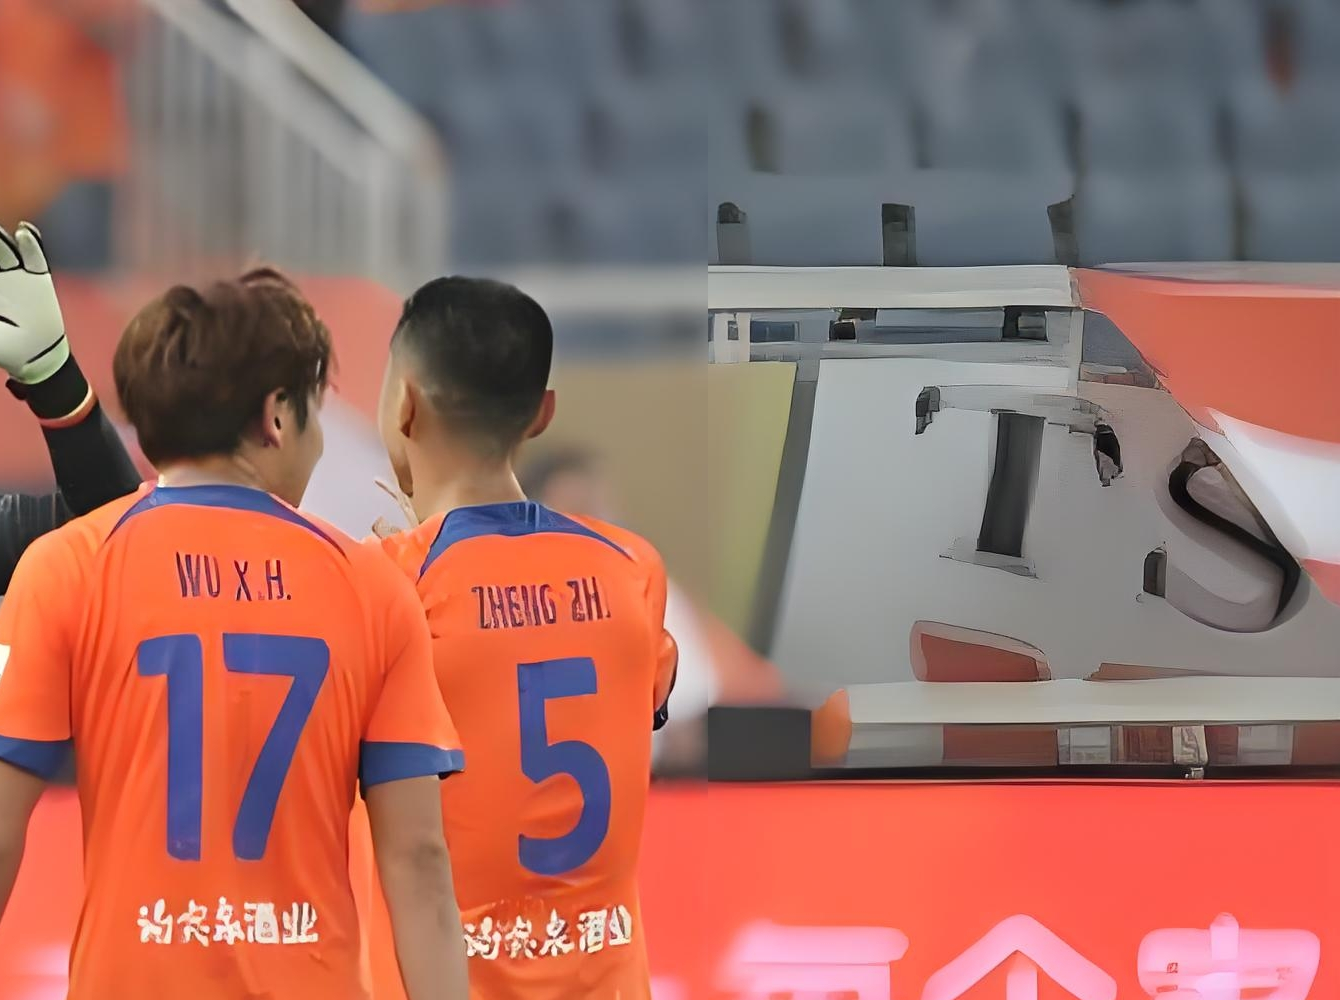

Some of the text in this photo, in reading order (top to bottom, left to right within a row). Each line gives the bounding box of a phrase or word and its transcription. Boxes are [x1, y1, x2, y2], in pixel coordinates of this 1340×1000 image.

[176, 551, 221, 598] WU
[137, 632, 331, 862] 17
[517, 656, 611, 875] 5
